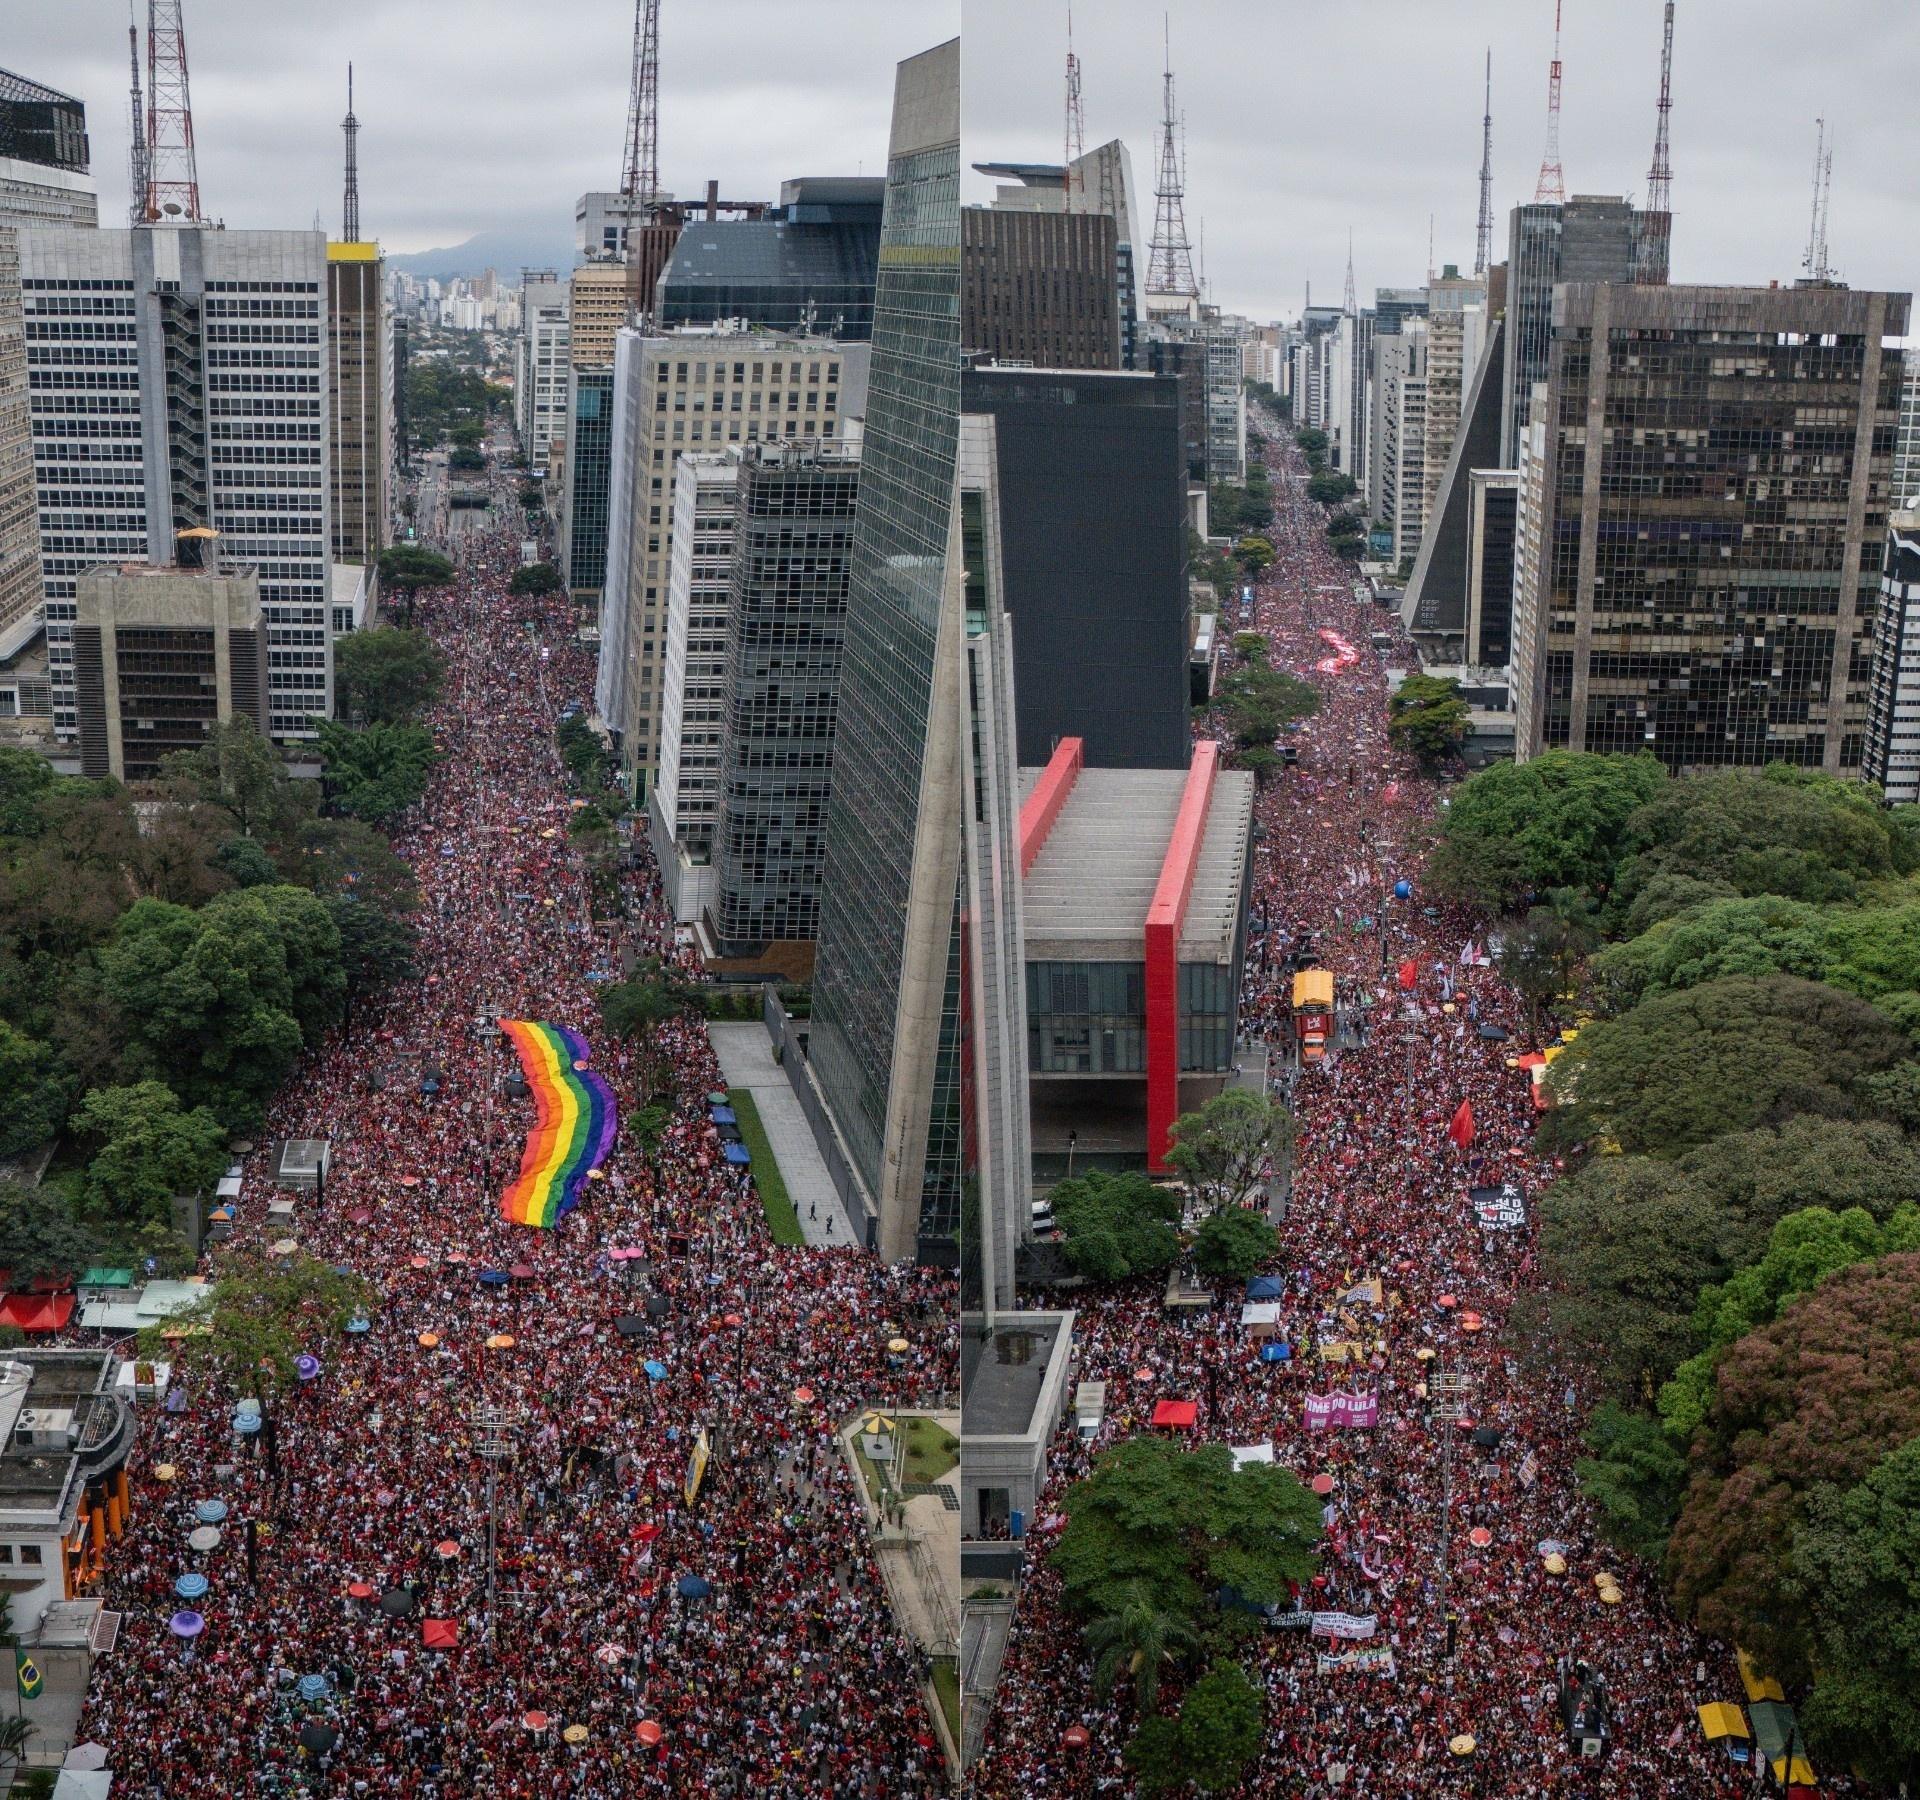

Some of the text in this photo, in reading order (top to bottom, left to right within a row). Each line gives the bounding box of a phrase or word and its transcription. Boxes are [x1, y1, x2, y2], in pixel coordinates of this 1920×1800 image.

[1304, 1397, 1376, 1413] TIME DO LULA
